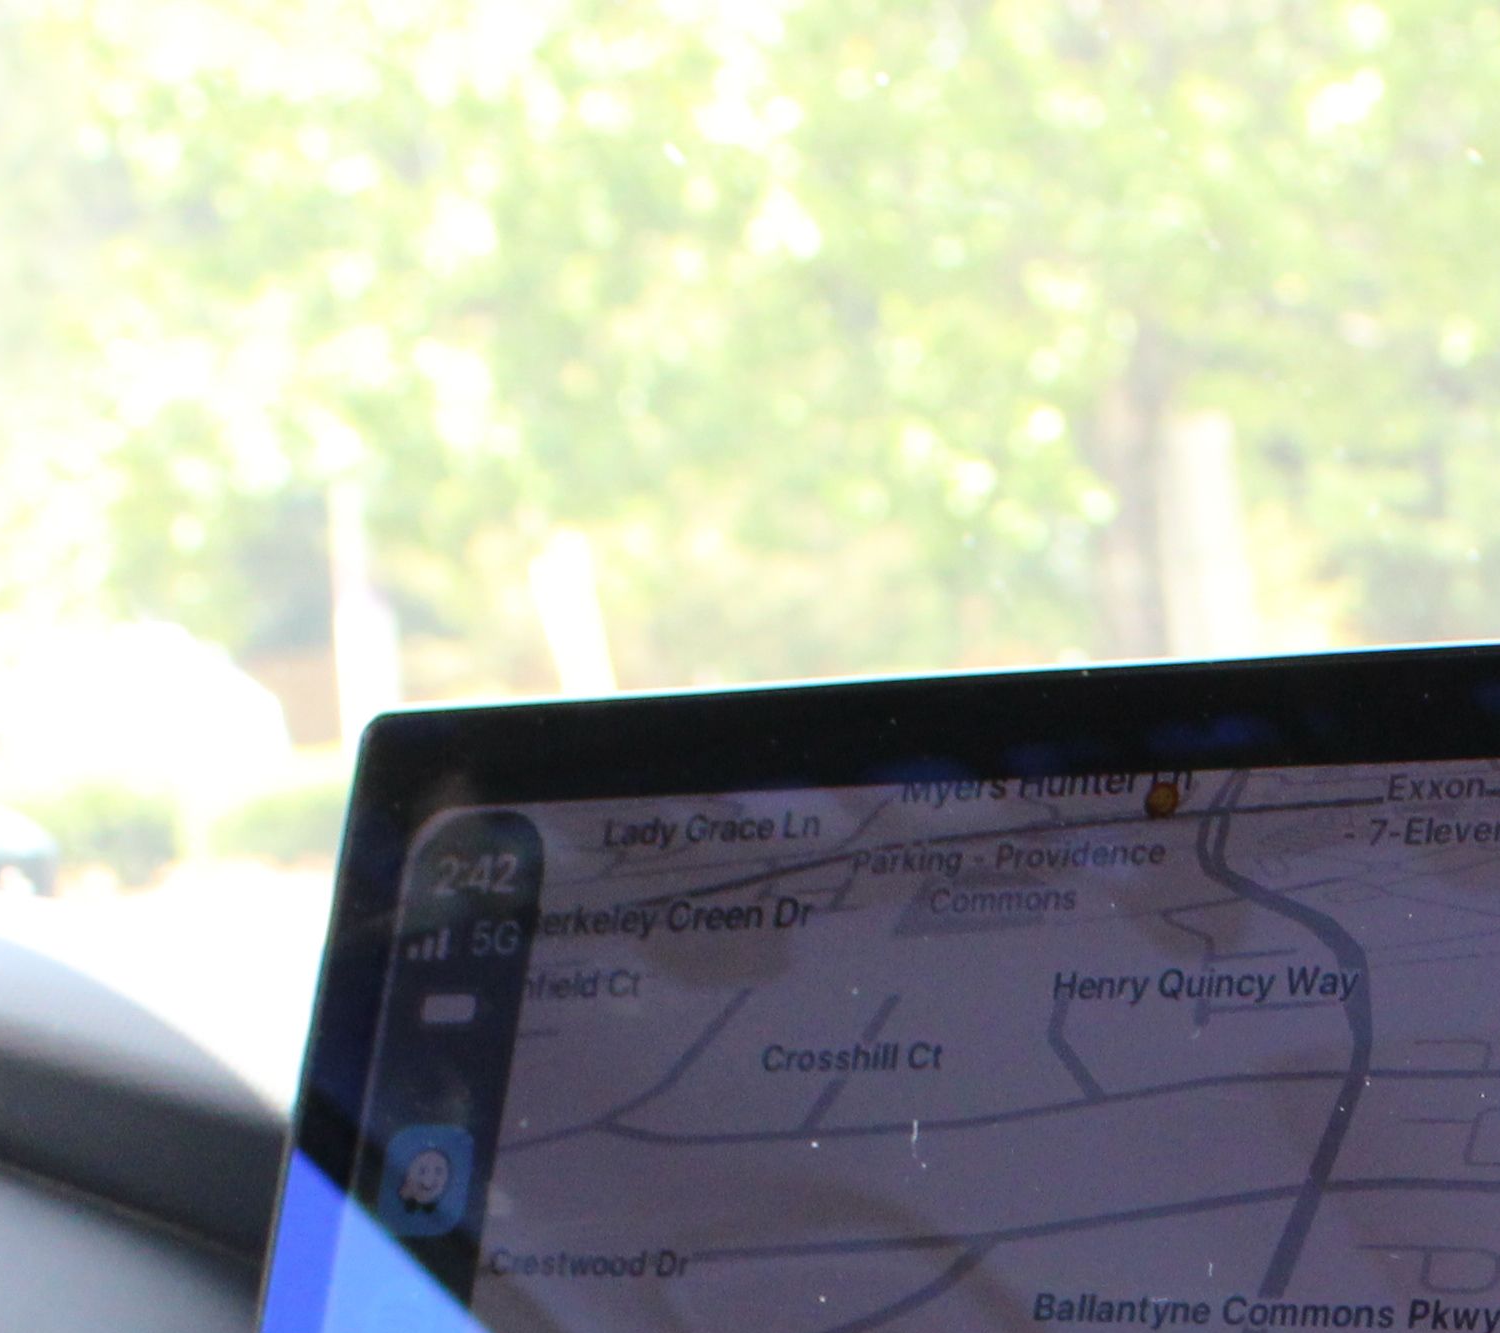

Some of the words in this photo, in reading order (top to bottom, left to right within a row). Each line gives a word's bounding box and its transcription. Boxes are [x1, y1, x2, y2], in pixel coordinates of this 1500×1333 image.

[1387, 774, 1485, 801] Exxon
[603, 817, 678, 850] Lady
[685, 813, 776, 843] Grace
[782, 809, 821, 840] Ln
[851, 847, 963, 877] Parking
[995, 842, 1167, 871] Providence
[930, 887, 1078, 914] Commons
[538, 902, 657, 941] erkeley
[773, 896, 813, 929] Dr
[470, 918, 522, 957] 5G
[608, 967, 640, 999] Ct
[1053, 971, 1149, 1003] Henry
[1156, 969, 1276, 1002] Quincy
[1285, 966, 1361, 1000] Way
[761, 1043, 899, 1073] Crosshill
[906, 1042, 944, 1071] Ct
[488, 1247, 650, 1280] Crestwood
[654, 1247, 690, 1279] Dr
[1032, 1292, 1211, 1330] Ballantyne
[1221, 1296, 1395, 1330] Commons
